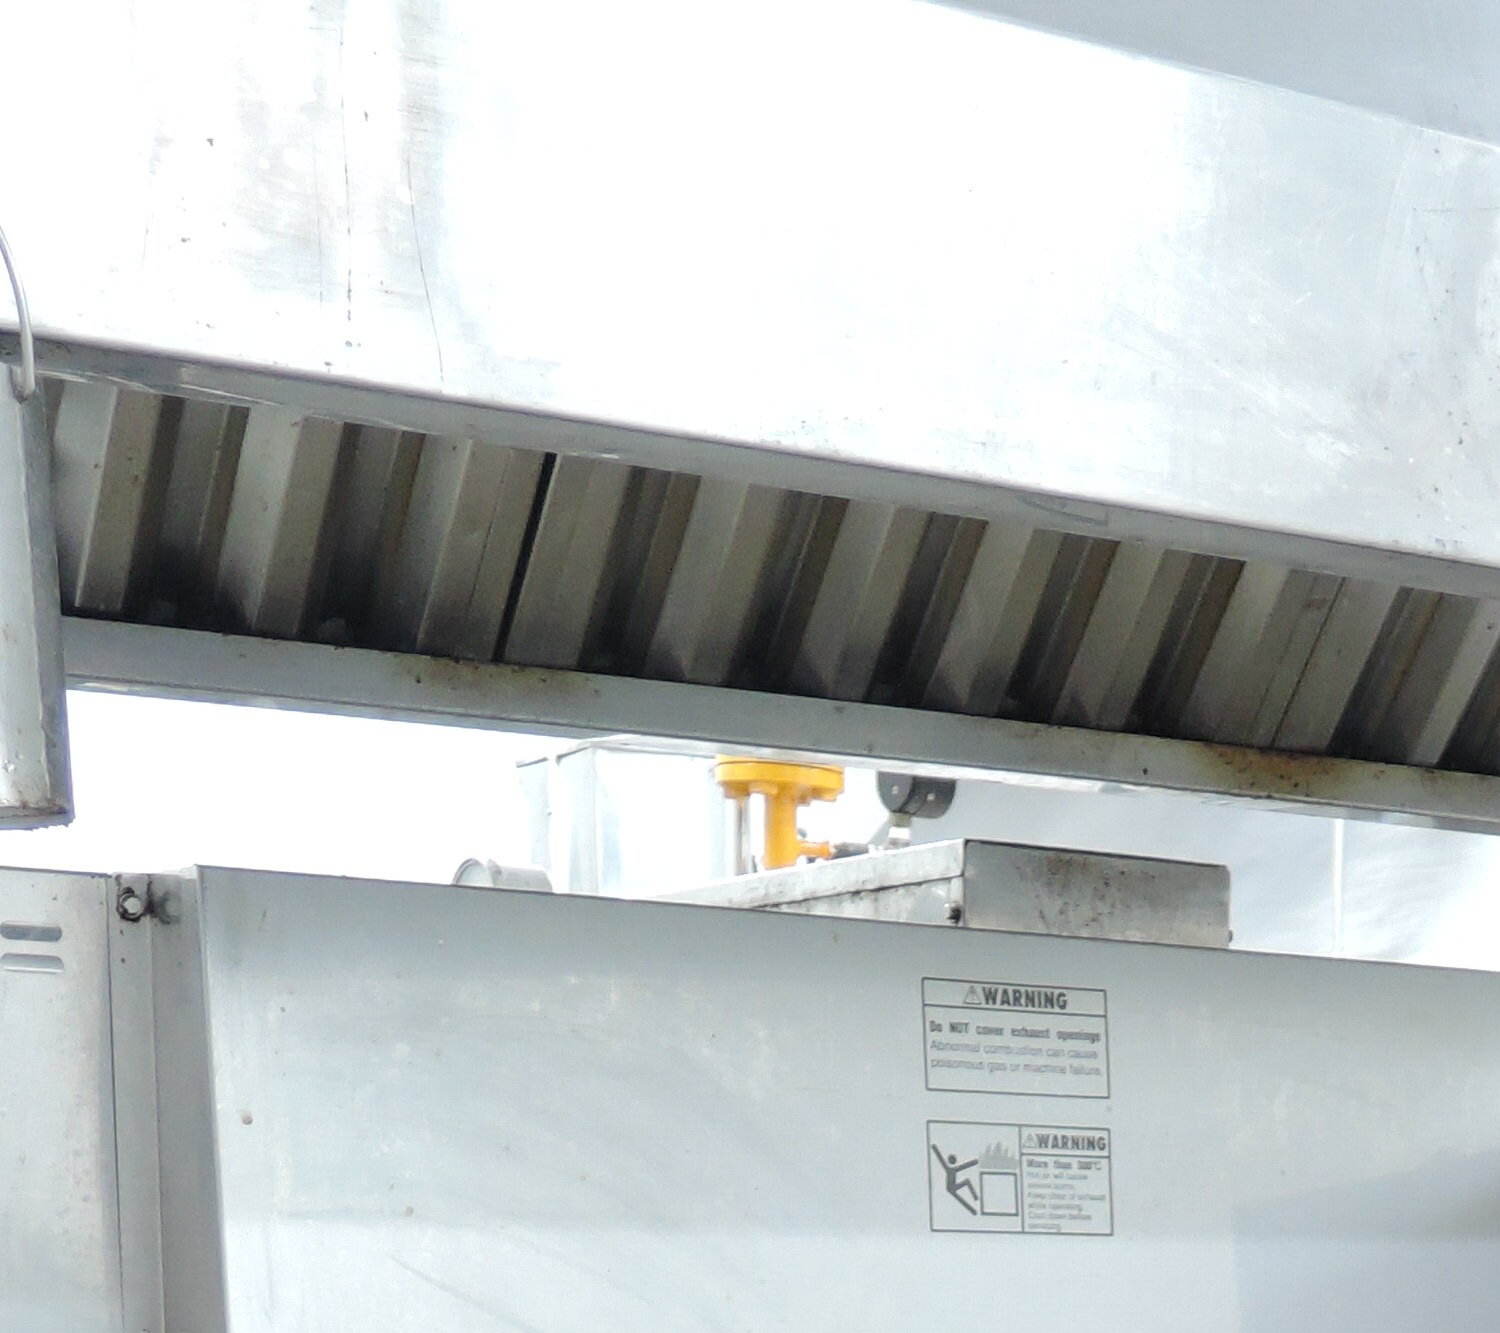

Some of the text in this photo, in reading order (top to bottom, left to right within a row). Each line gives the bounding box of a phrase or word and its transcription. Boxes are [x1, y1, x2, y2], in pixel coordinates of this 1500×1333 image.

[982, 985, 1068, 1010] WARNING
[929, 1020, 943, 1032] Do
[949, 1021, 969, 1034] NOT
[1035, 1132, 1106, 1151] WARNING
